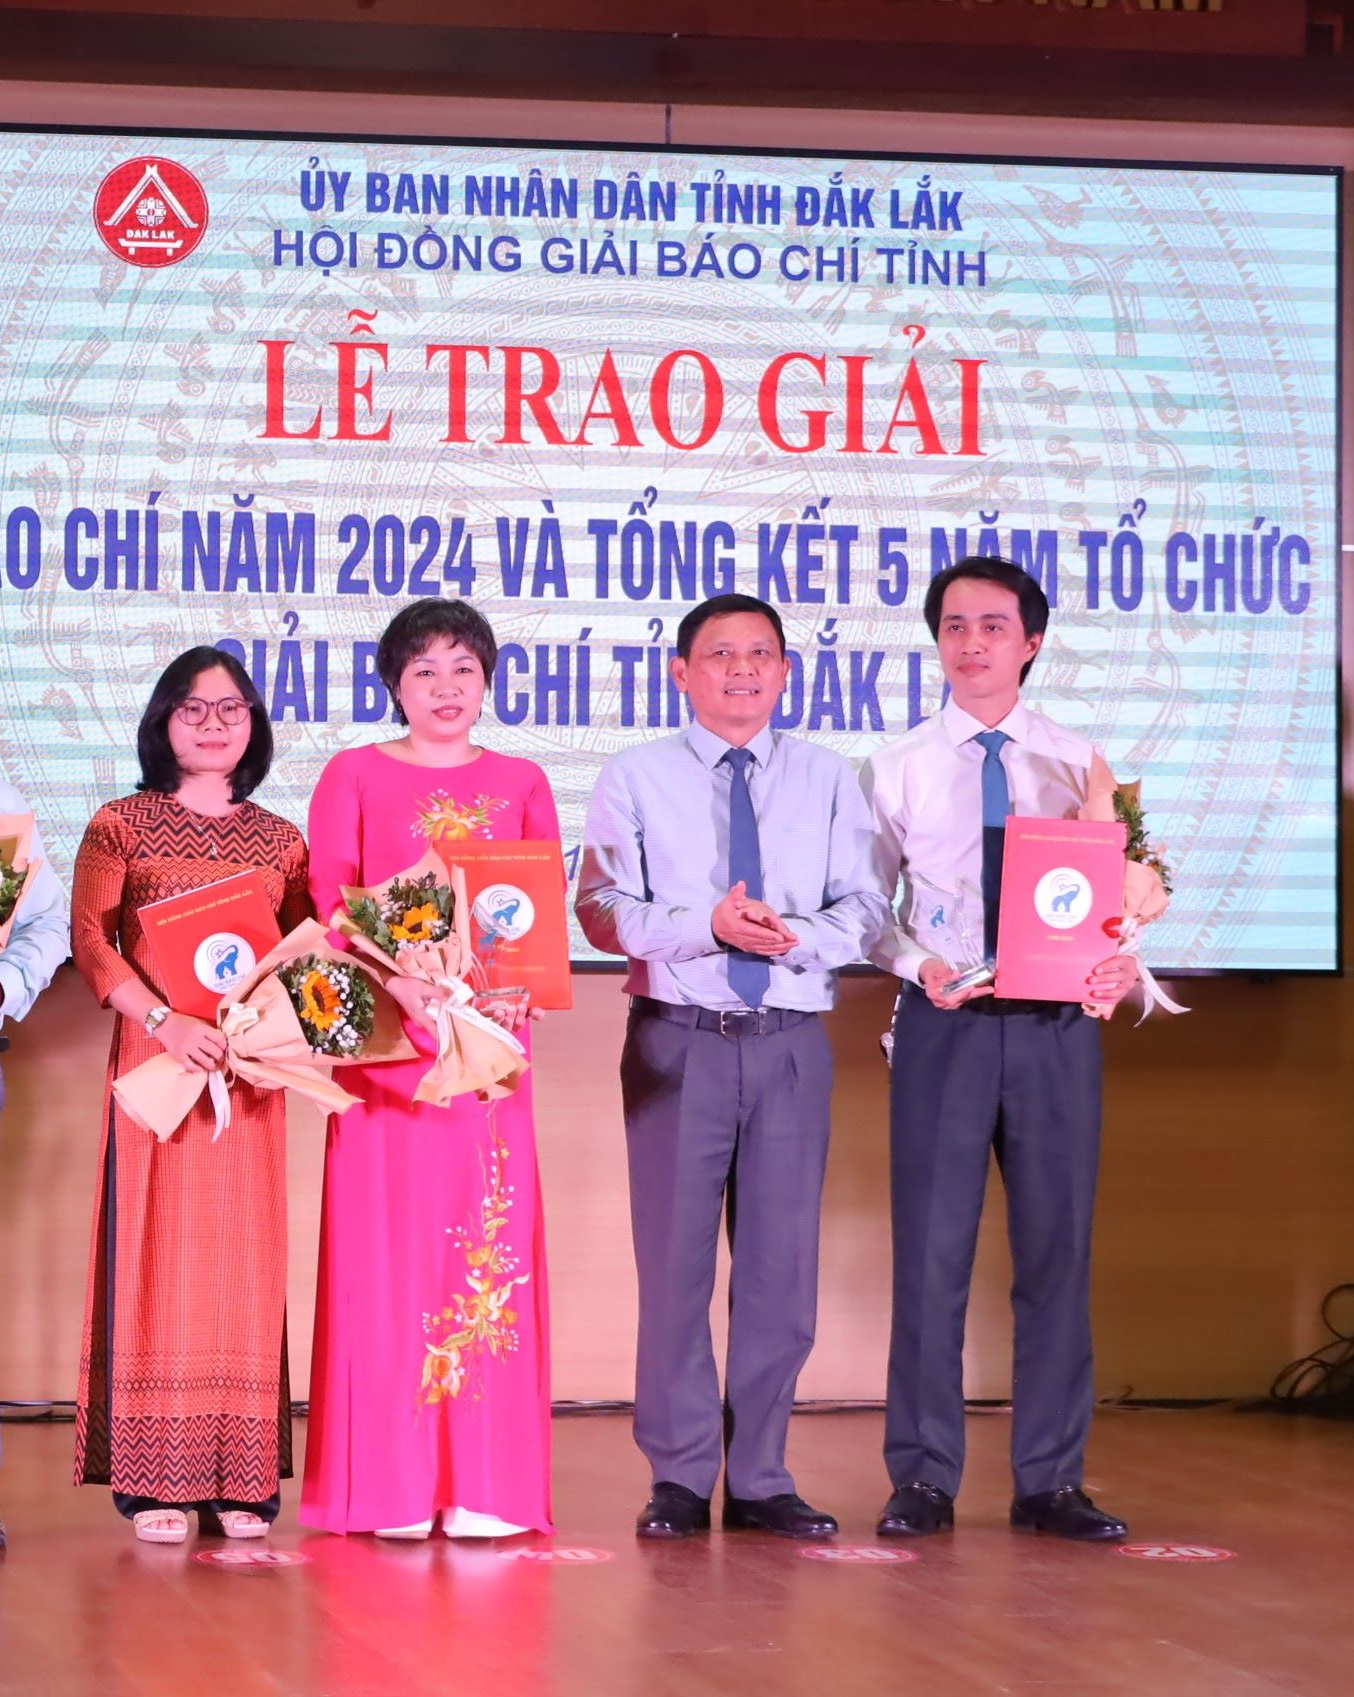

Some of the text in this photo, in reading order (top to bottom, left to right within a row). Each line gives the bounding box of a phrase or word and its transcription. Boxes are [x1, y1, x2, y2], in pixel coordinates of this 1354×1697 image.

[301, 156, 964, 232] ỦY BAN NHÂN DÂN TỈNH ĐẮK LẮK
[126, 229, 175, 240] DAK LAK
[273, 224, 986, 288] HỘI ĐỒNG GIẢI BÁO CHÍ TỈNH
[256, 308, 987, 457] LỄ TRAO GIẢI
[63, 490, 159, 592] CHÍ
[182, 493, 316, 594] NĂM
[337, 513, 477, 598] 2024
[496, 499, 569, 598] VÀ
[587, 486, 736, 603] TỔNG
[757, 496, 859, 605] KẾT
[878, 527, 909, 608] 5
[1078, 498, 1144, 612] TỔ
[1165, 516, 1311, 615] CHỨC
[494, 627, 593, 728] CHÍ
[1130, 1546, 1217, 1558] 02
